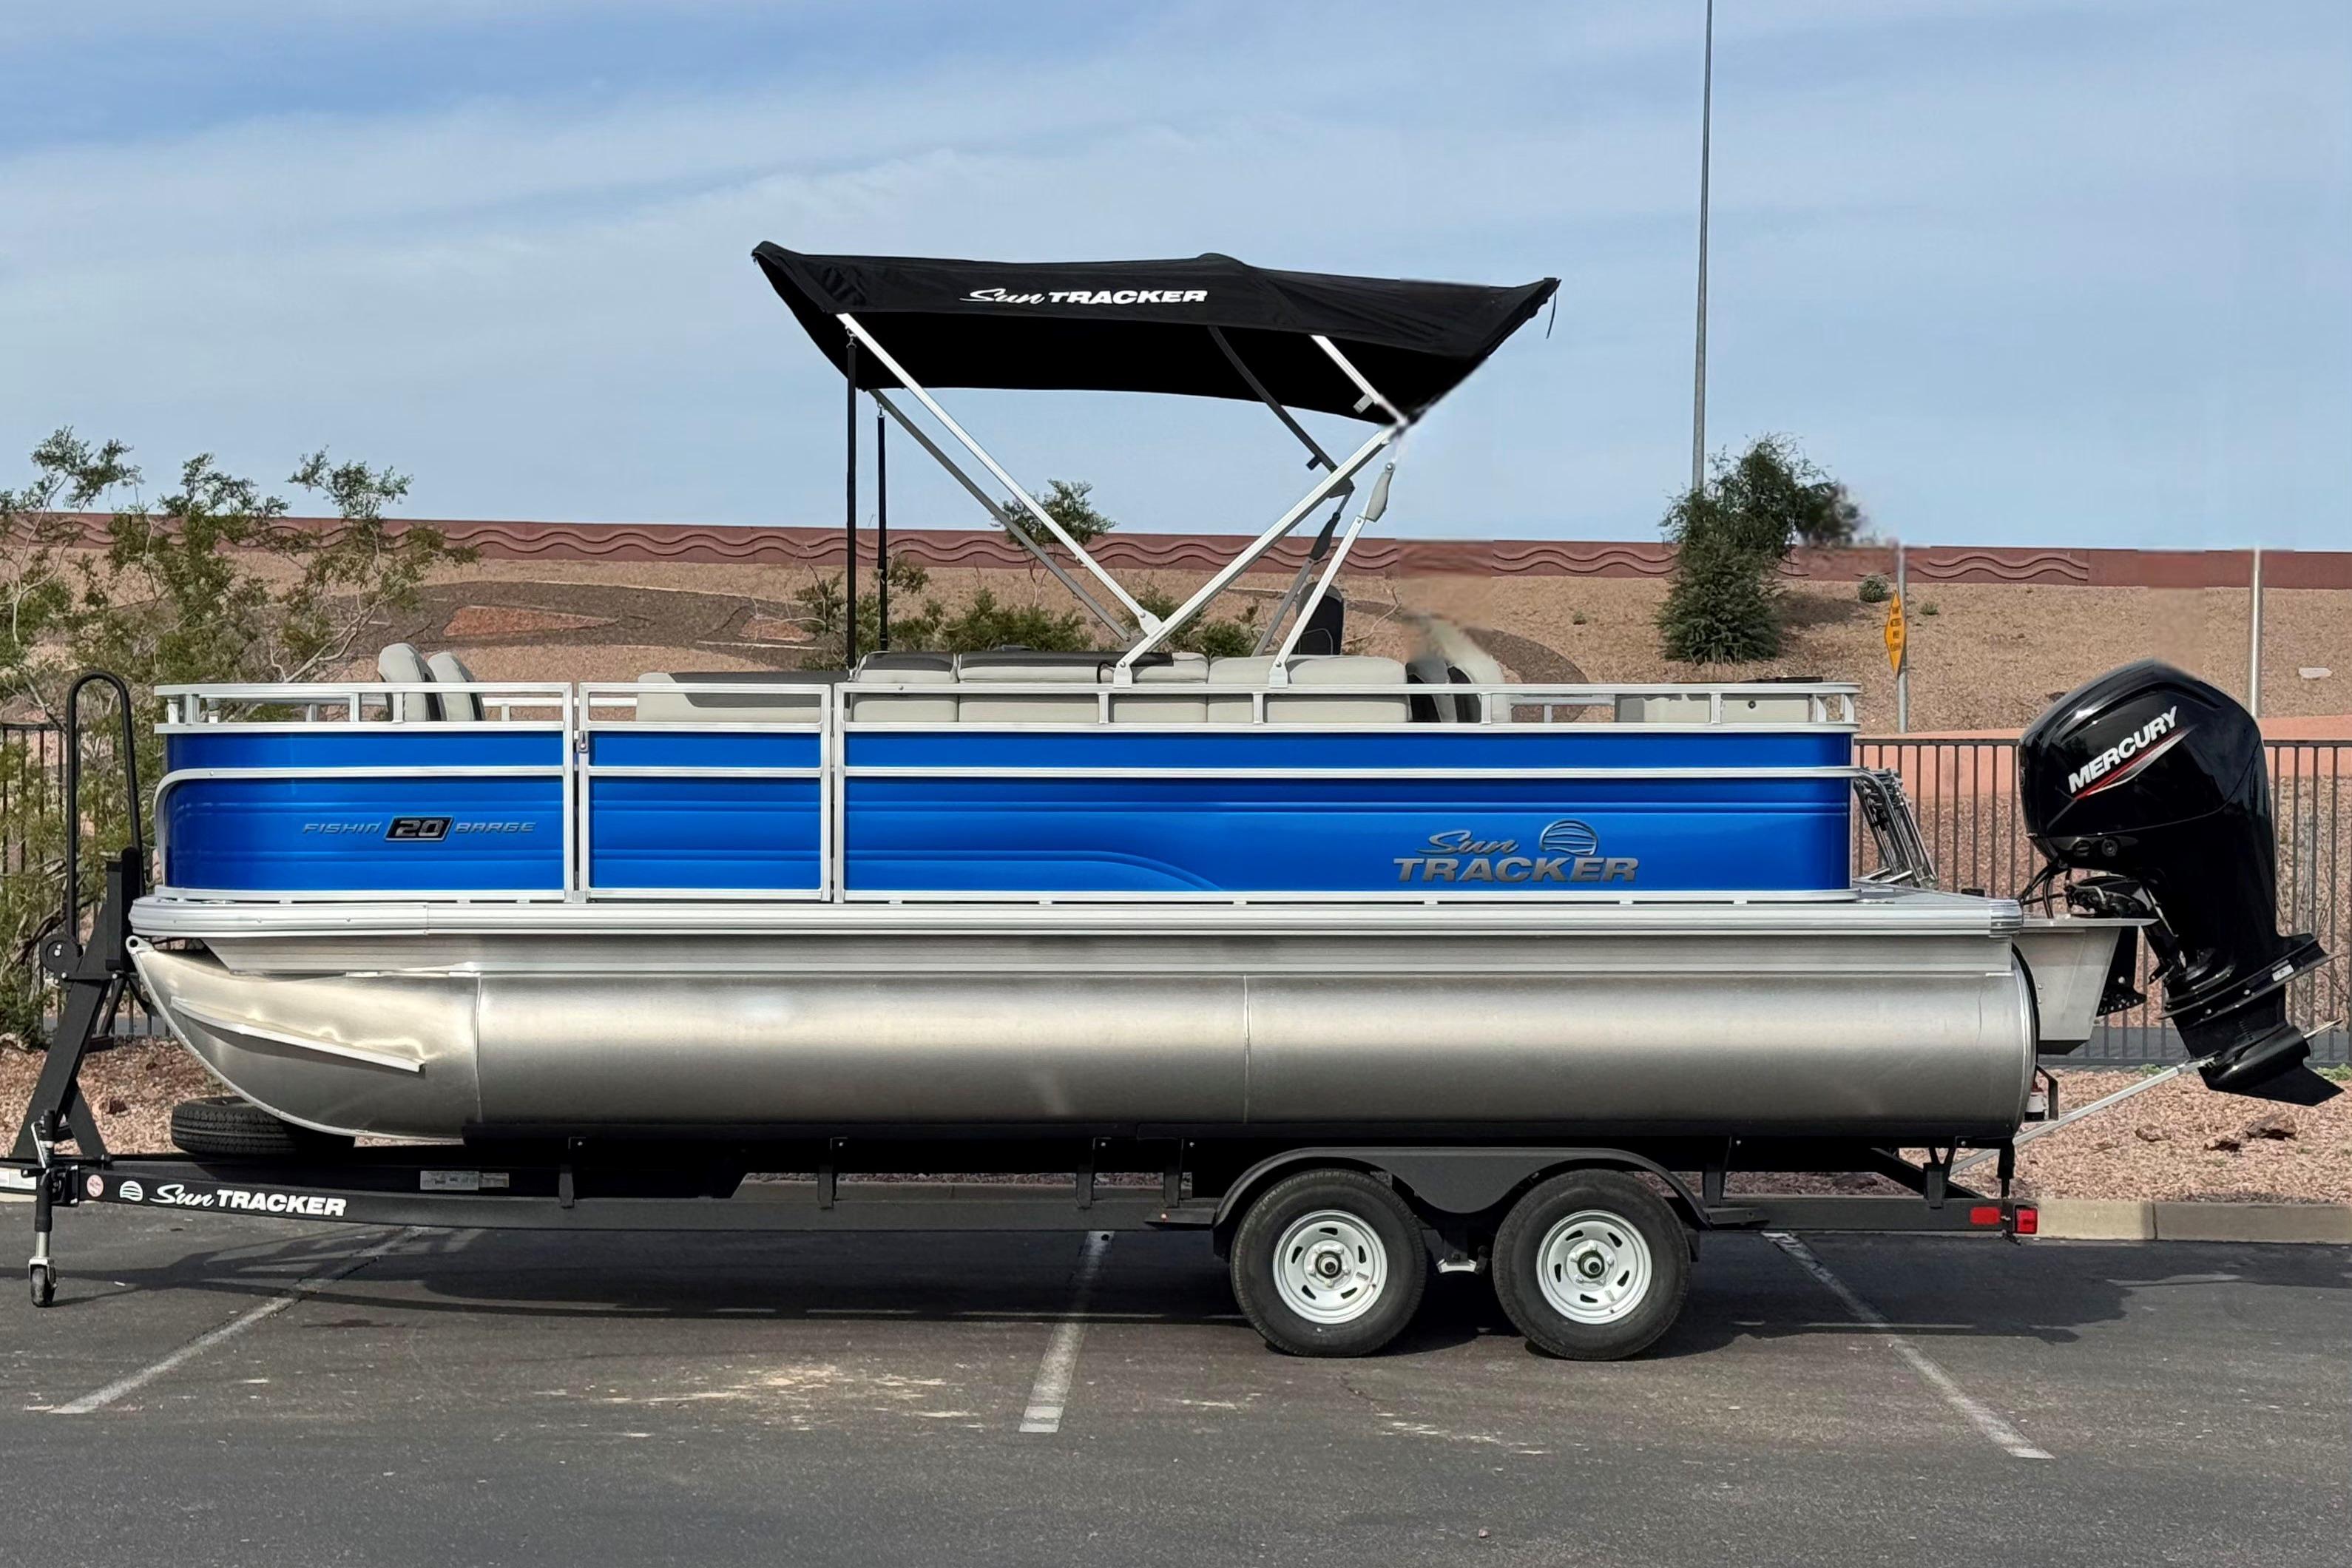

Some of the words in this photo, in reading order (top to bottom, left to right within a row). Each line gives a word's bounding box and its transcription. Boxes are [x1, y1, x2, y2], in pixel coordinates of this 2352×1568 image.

[959, 288, 1047, 305] Sun
[1049, 289, 1209, 305] TRACKER
[2068, 706, 2178, 794] MERCURY
[395, 819, 445, 837] 20
[454, 822, 537, 833] BARGE
[1416, 830, 1519, 855] Sun
[1393, 856, 1639, 882] TRACKER
[149, 1183, 215, 1207] Sun
[216, 1189, 347, 1217] TRACKER
